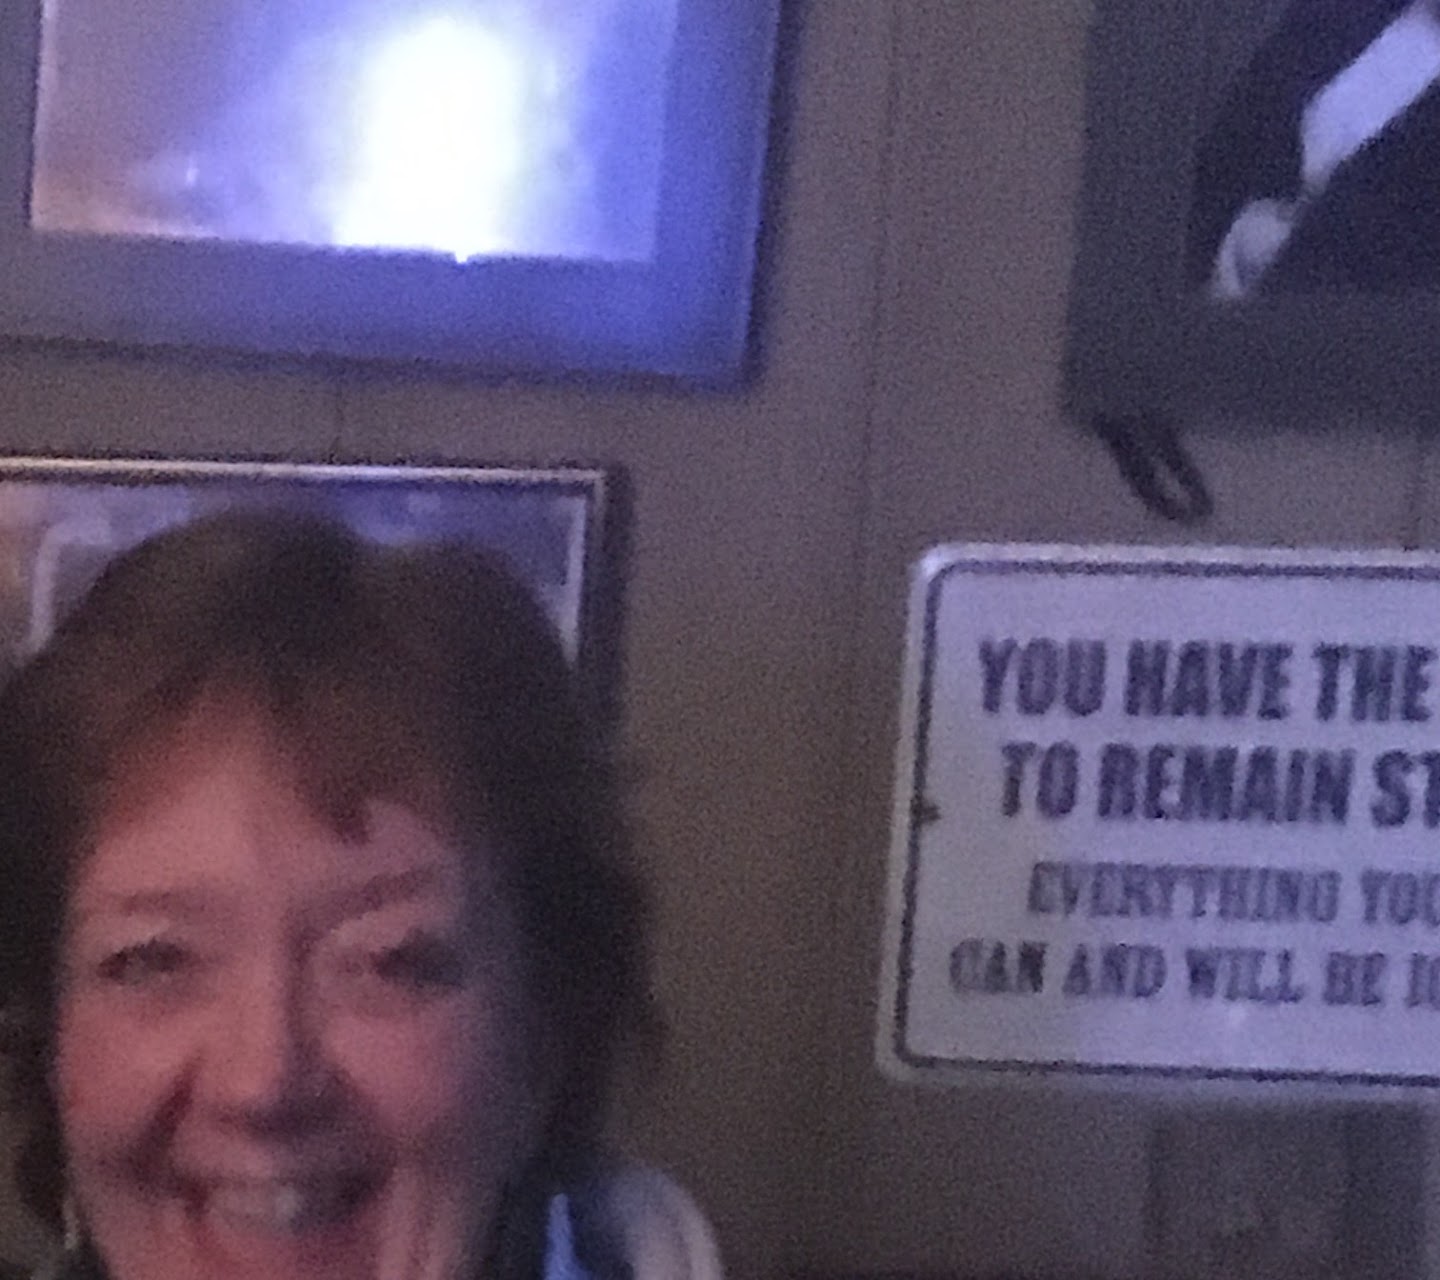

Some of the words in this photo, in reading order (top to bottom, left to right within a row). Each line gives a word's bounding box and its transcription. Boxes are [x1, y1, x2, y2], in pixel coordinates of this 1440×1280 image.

[979, 636, 1107, 717] YOU
[1124, 638, 1295, 720] HAVE
[1312, 641, 1436, 722] THE
[1001, 739, 1080, 820] TO
[1096, 743, 1354, 826] REMAIN
[1027, 860, 1341, 924] EVERYTHING
[949, 937, 1048, 994] CAN
[1062, 943, 1167, 998] AND
[1185, 946, 1303, 1005] WILL
[1323, 952, 1387, 1006] BE
